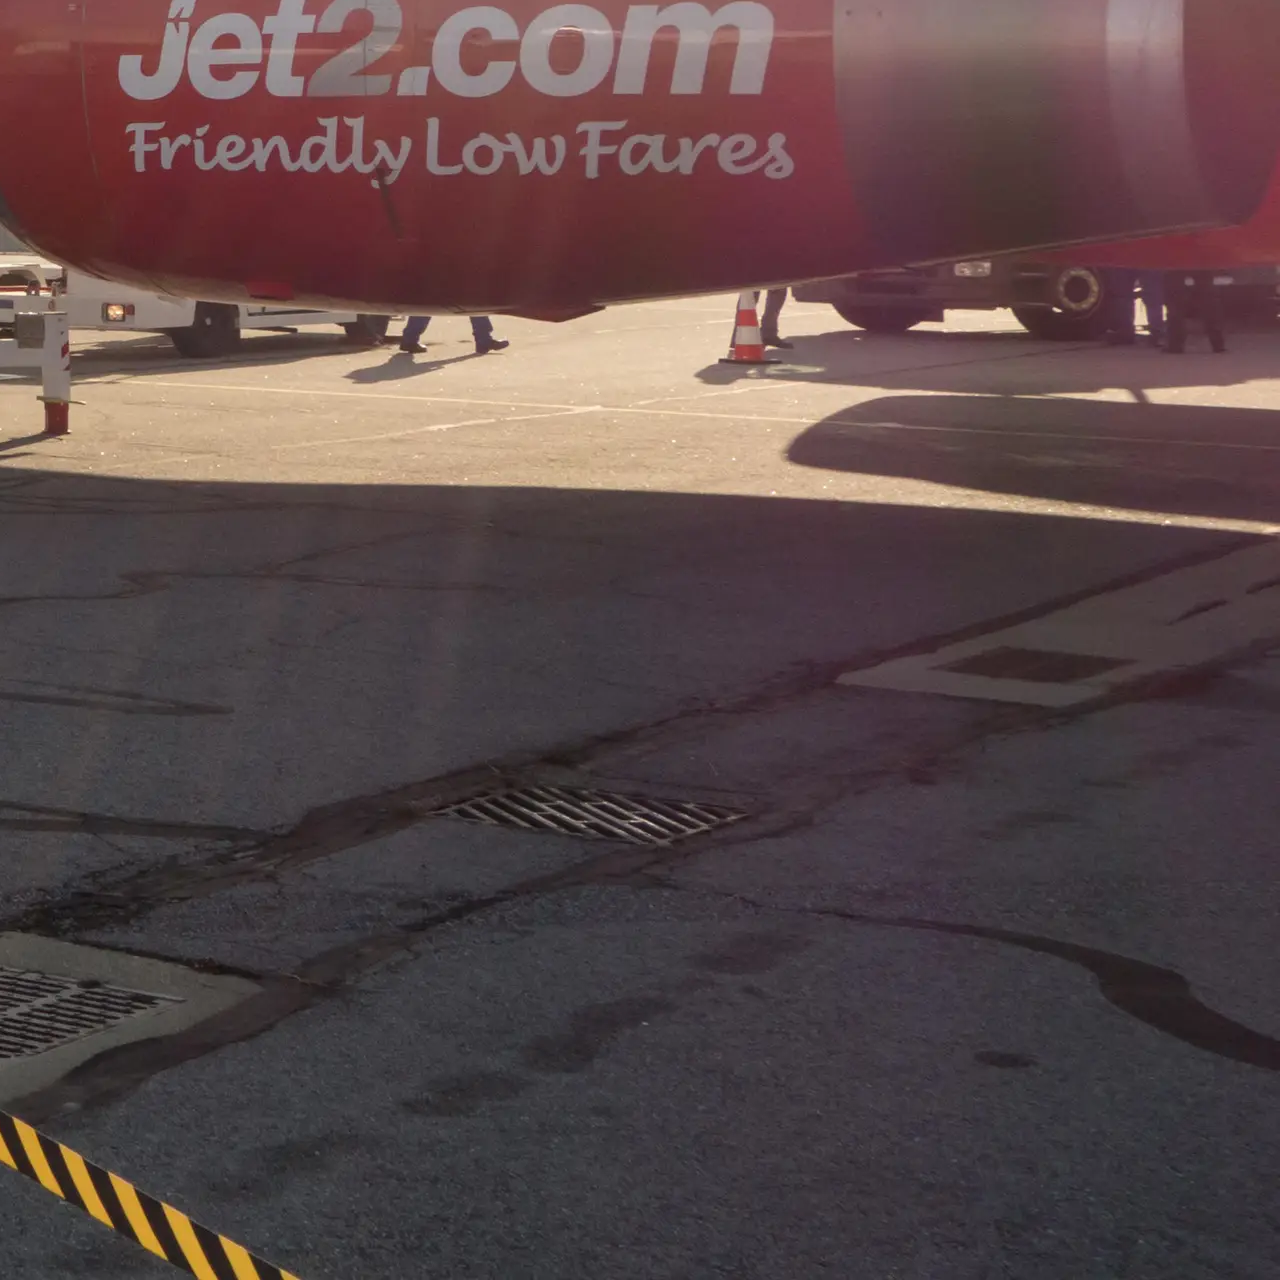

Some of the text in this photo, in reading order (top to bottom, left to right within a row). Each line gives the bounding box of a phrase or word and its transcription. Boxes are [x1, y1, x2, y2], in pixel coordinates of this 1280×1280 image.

[125, 115, 794, 189] Friendly Low Fares
